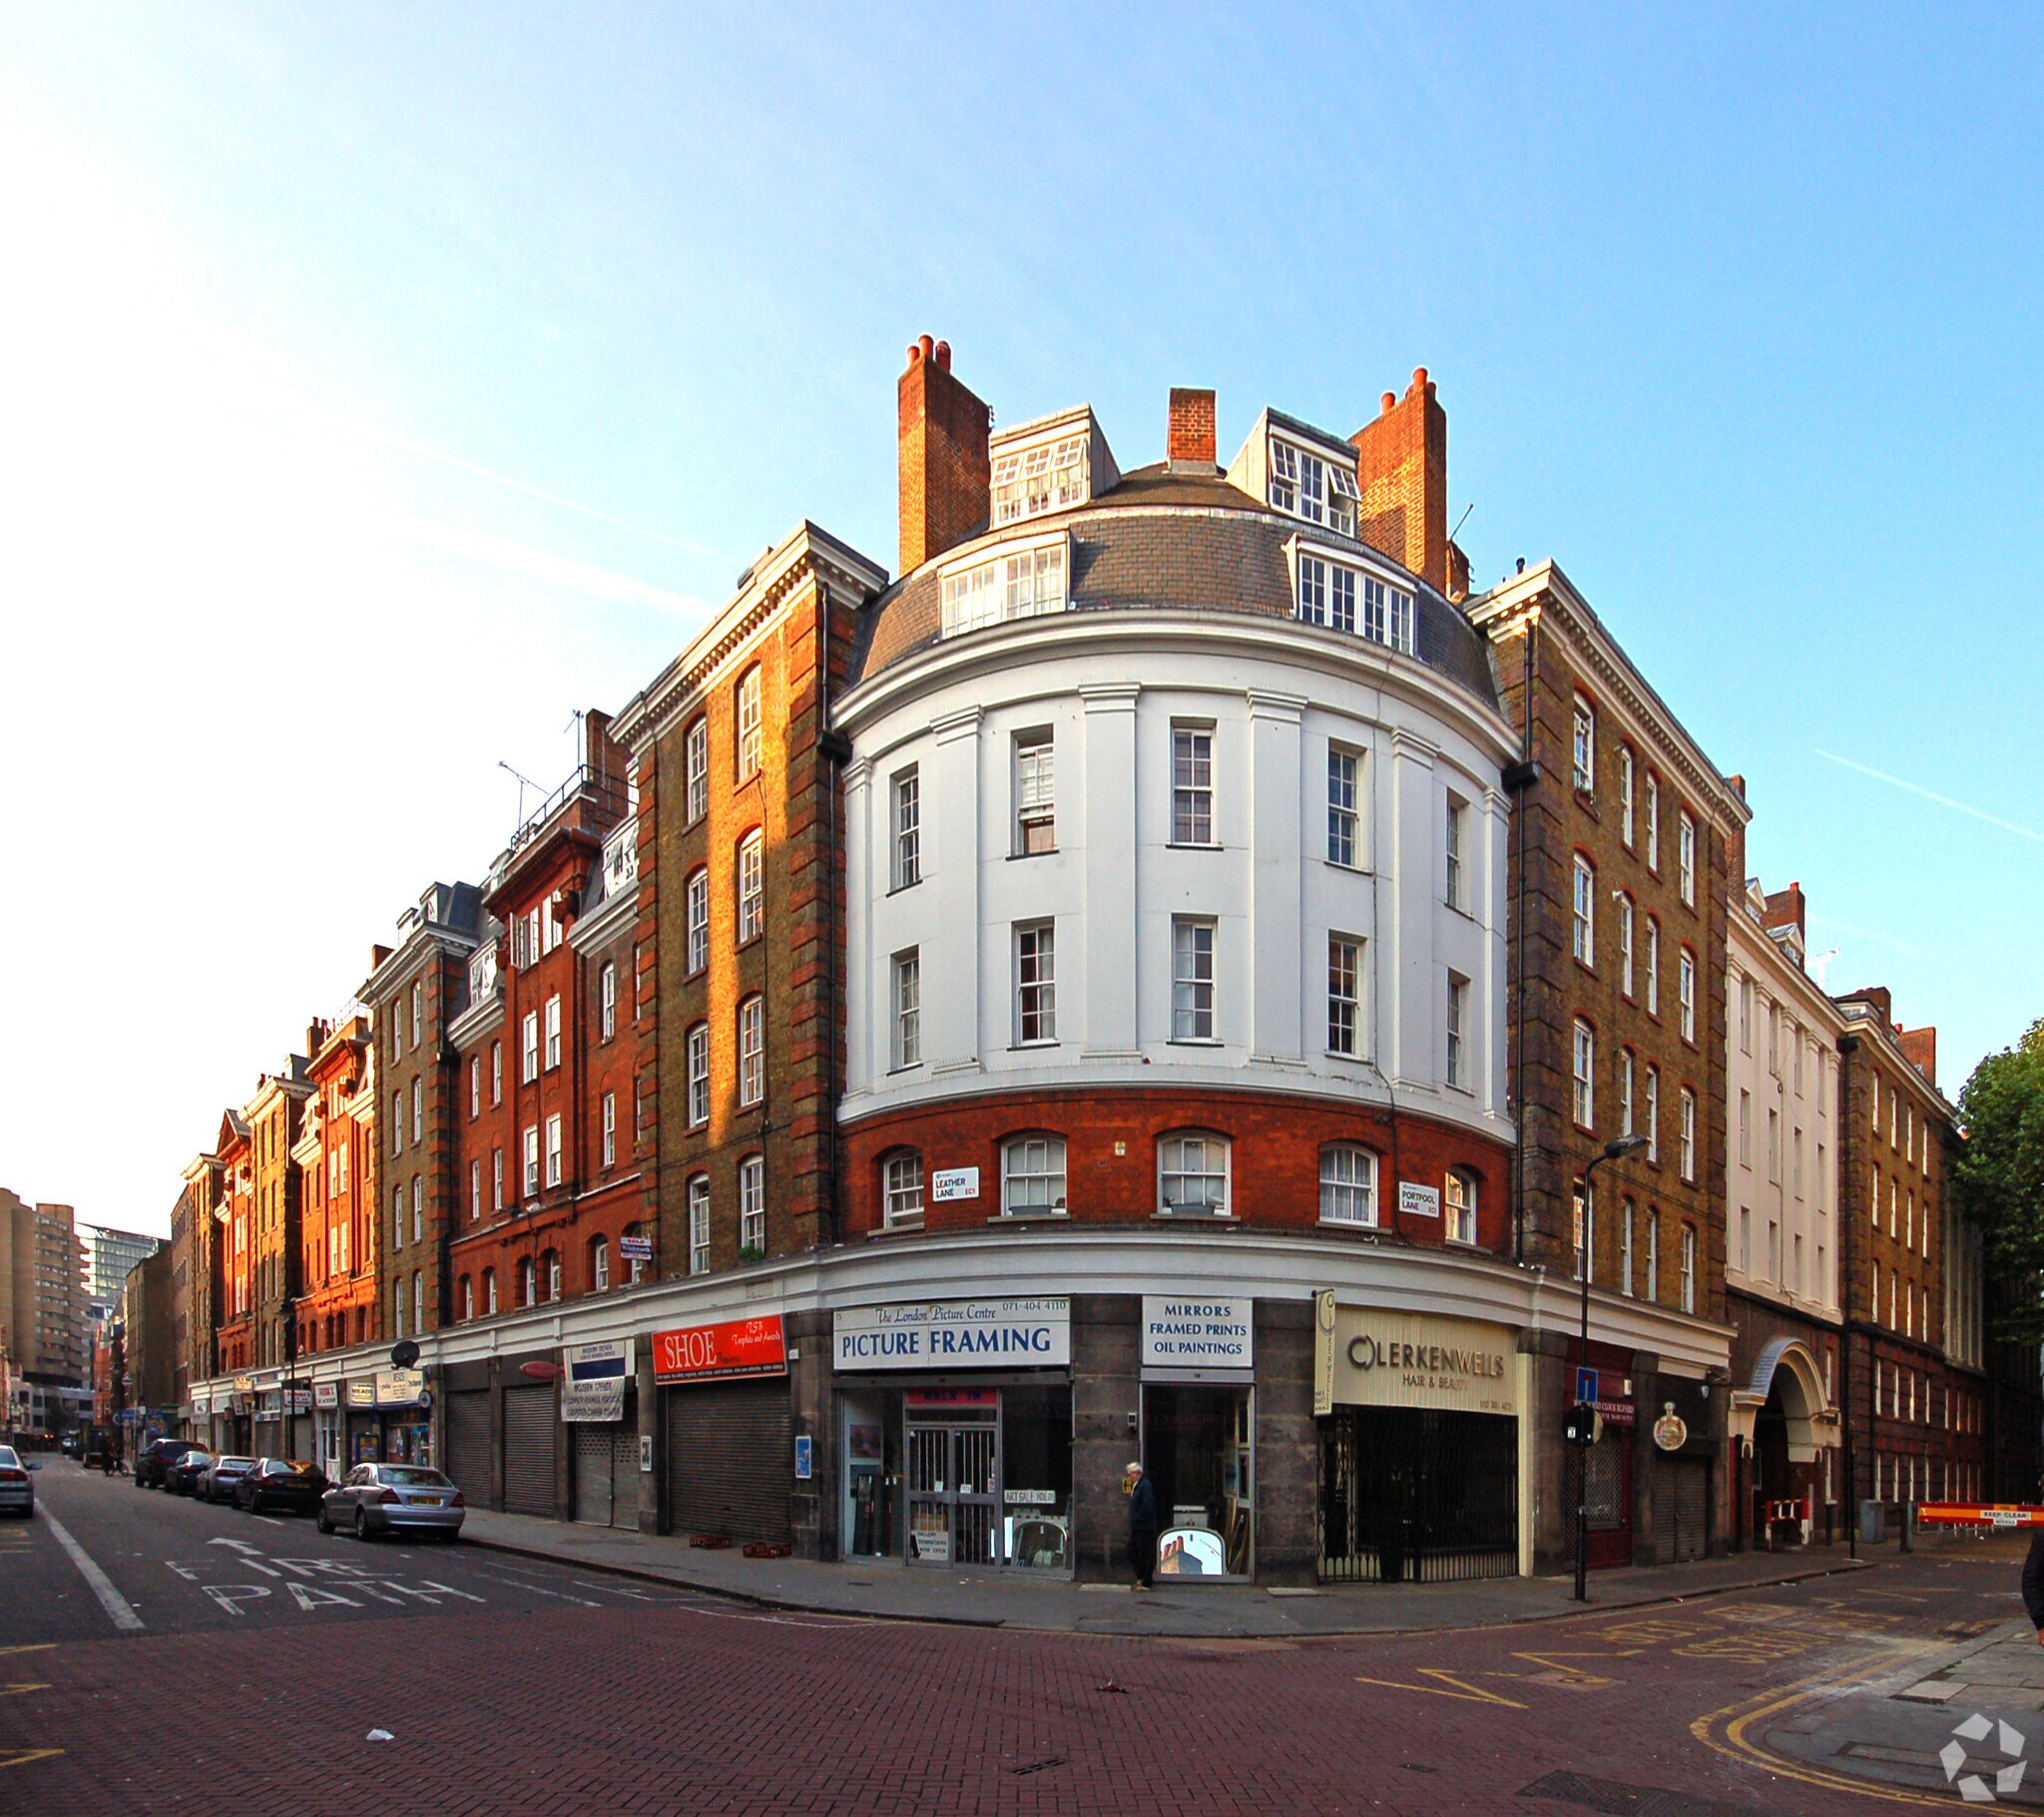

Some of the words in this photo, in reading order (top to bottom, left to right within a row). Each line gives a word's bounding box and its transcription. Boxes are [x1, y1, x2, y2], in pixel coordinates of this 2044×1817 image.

[936, 1177, 966, 1188] LEATHER
[936, 1188, 954, 1197] LANE
[1402, 1200, 1418, 1210] LANE
[1002, 1301, 1041, 1311] 071-404
[1044, 1300, 1067, 1310] 4110
[1165, 1304, 1231, 1317] MIRRORS
[875, 1308, 891, 1324] The
[893, 1307, 928, 1323] London
[929, 1304, 964, 1321] Picture
[966, 1303, 996, 1320] Centre
[1150, 1322, 1202, 1335] FRAMED
[1206, 1324, 1247, 1336] PRINTS
[665, 1330, 717, 1369] SHOE
[842, 1331, 919, 1358] PICTURE
[930, 1327, 1050, 1354] FRAMING
[1154, 1341, 1175, 1353] OIL
[1179, 1341, 1243, 1355] PAINTINGS
[1402, 1373, 1424, 1387] HAIR
[1428, 1376, 1434, 1388] &
[165, 1558, 406, 1581] FIRE
[201, 1580, 488, 1615] PATH
